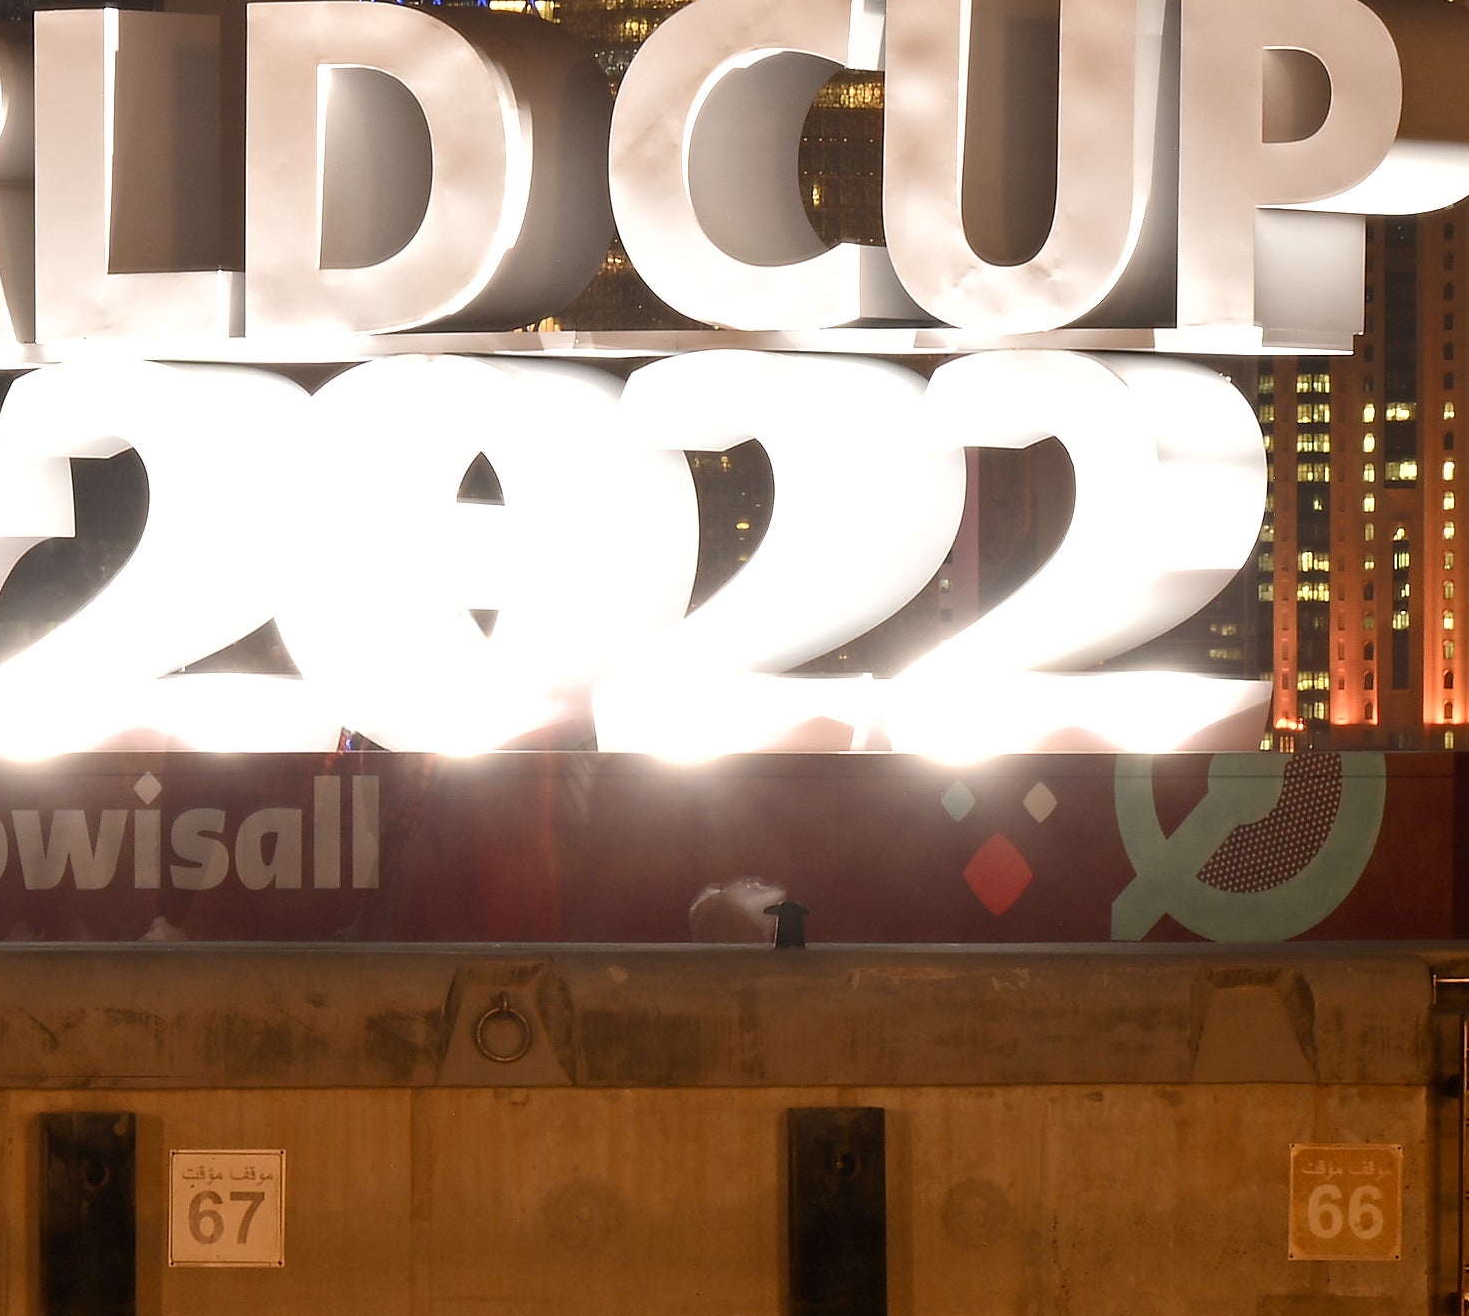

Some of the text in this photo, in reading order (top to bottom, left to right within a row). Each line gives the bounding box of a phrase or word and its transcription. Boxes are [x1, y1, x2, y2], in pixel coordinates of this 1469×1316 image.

[229, 1166, 274, 1186] موقف
[188, 1190, 265, 1245] 67
[1307, 1183, 1384, 1240] 66
